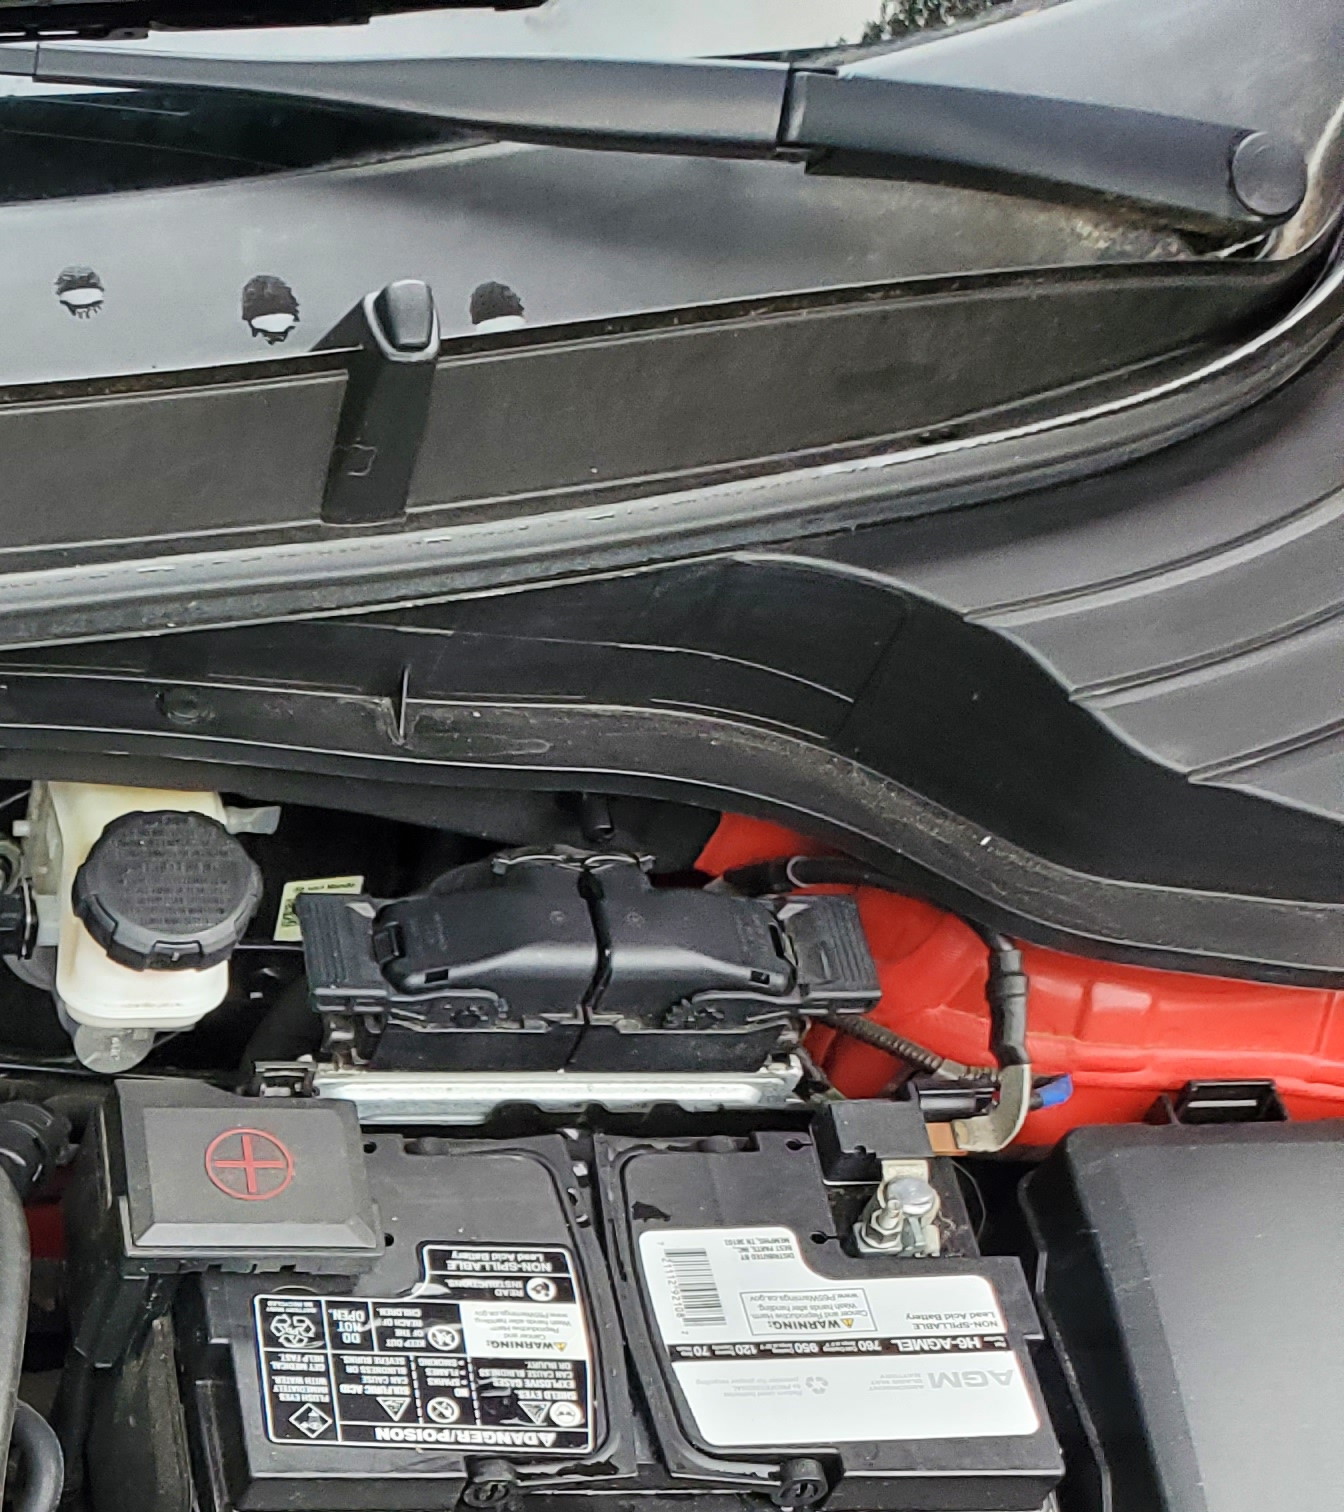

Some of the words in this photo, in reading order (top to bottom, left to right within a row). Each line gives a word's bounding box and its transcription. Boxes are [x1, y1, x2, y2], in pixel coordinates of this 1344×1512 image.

[517, 1253, 544, 1262] Lead
[446, 1260, 552, 1272] NON-SPILLABLE
[905, 1312, 941, 1321] Battery
[944, 1312, 966, 1320] Acid
[969, 1311, 995, 1319] Lead
[768, 1320, 840, 1330] WARNING:
[912, 1320, 998, 1330] NON-SPILLABLE
[342, 1332, 361, 1344] DO
[486, 1340, 554, 1350] WARNING:
[795, 1342, 819, 1353] 950
[858, 1340, 882, 1351] 760
[890, 1336, 980, 1351] H6-AGMEL
[693, 1346, 710, 1356] 70
[735, 1344, 758, 1355] 120
[927, 1369, 1014, 1389] AGM
[375, 1426, 538, 1445] DANGER/POISON
